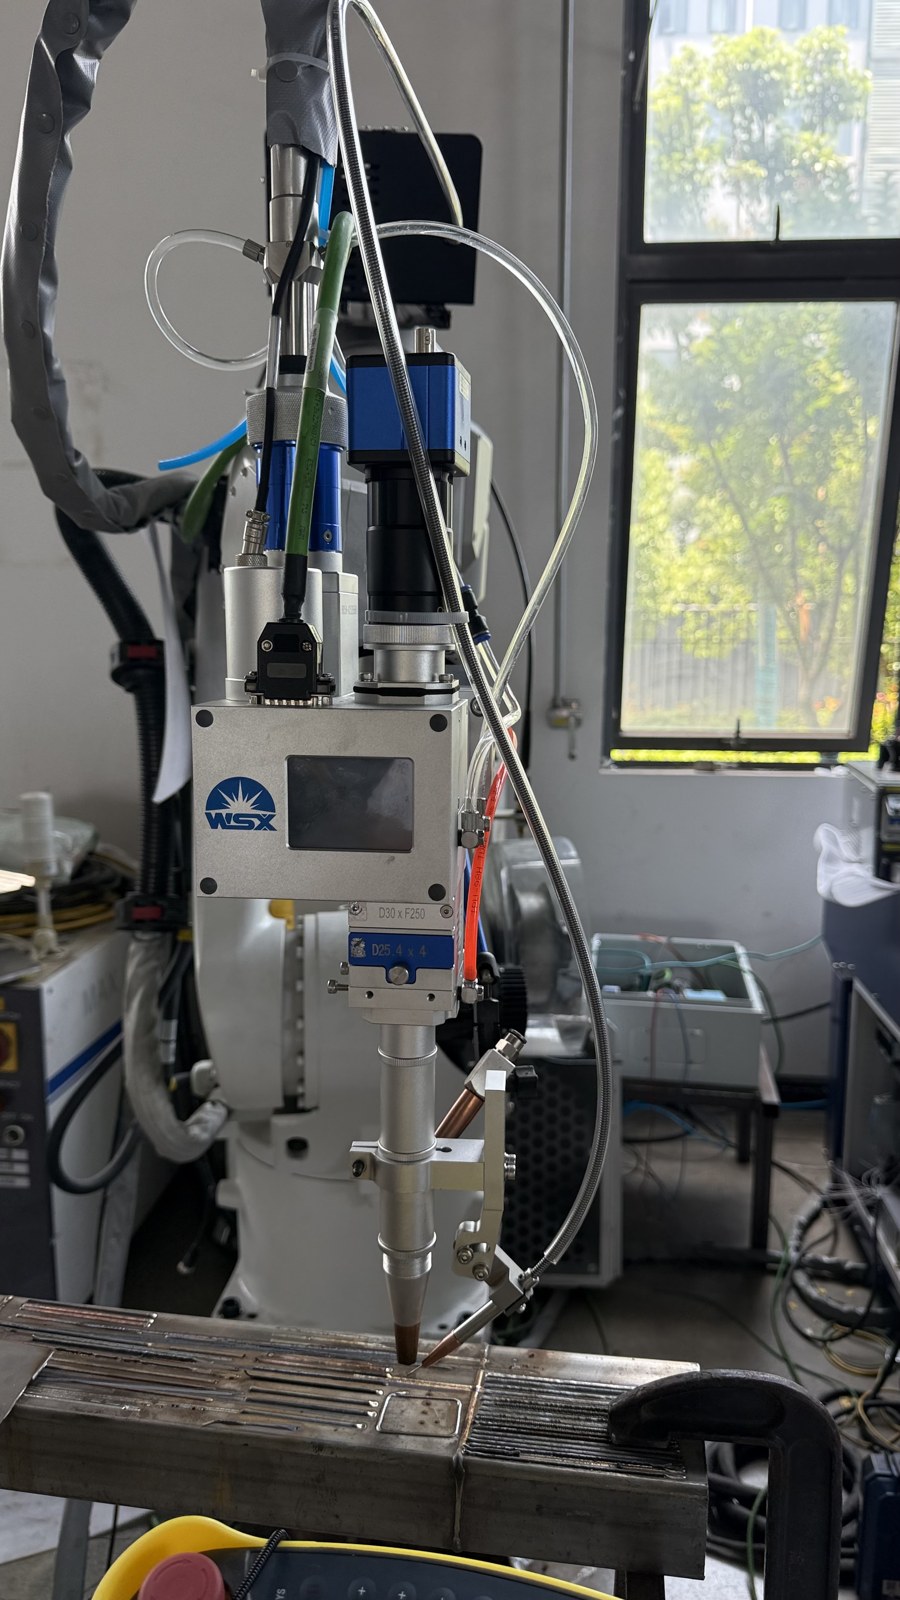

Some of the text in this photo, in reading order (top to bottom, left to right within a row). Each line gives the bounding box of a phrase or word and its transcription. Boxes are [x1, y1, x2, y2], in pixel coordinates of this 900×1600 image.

[204, 811, 278, 831] WSX
[378, 906, 426, 920] D30 x F250
[418, 945, 427, 958] 4
